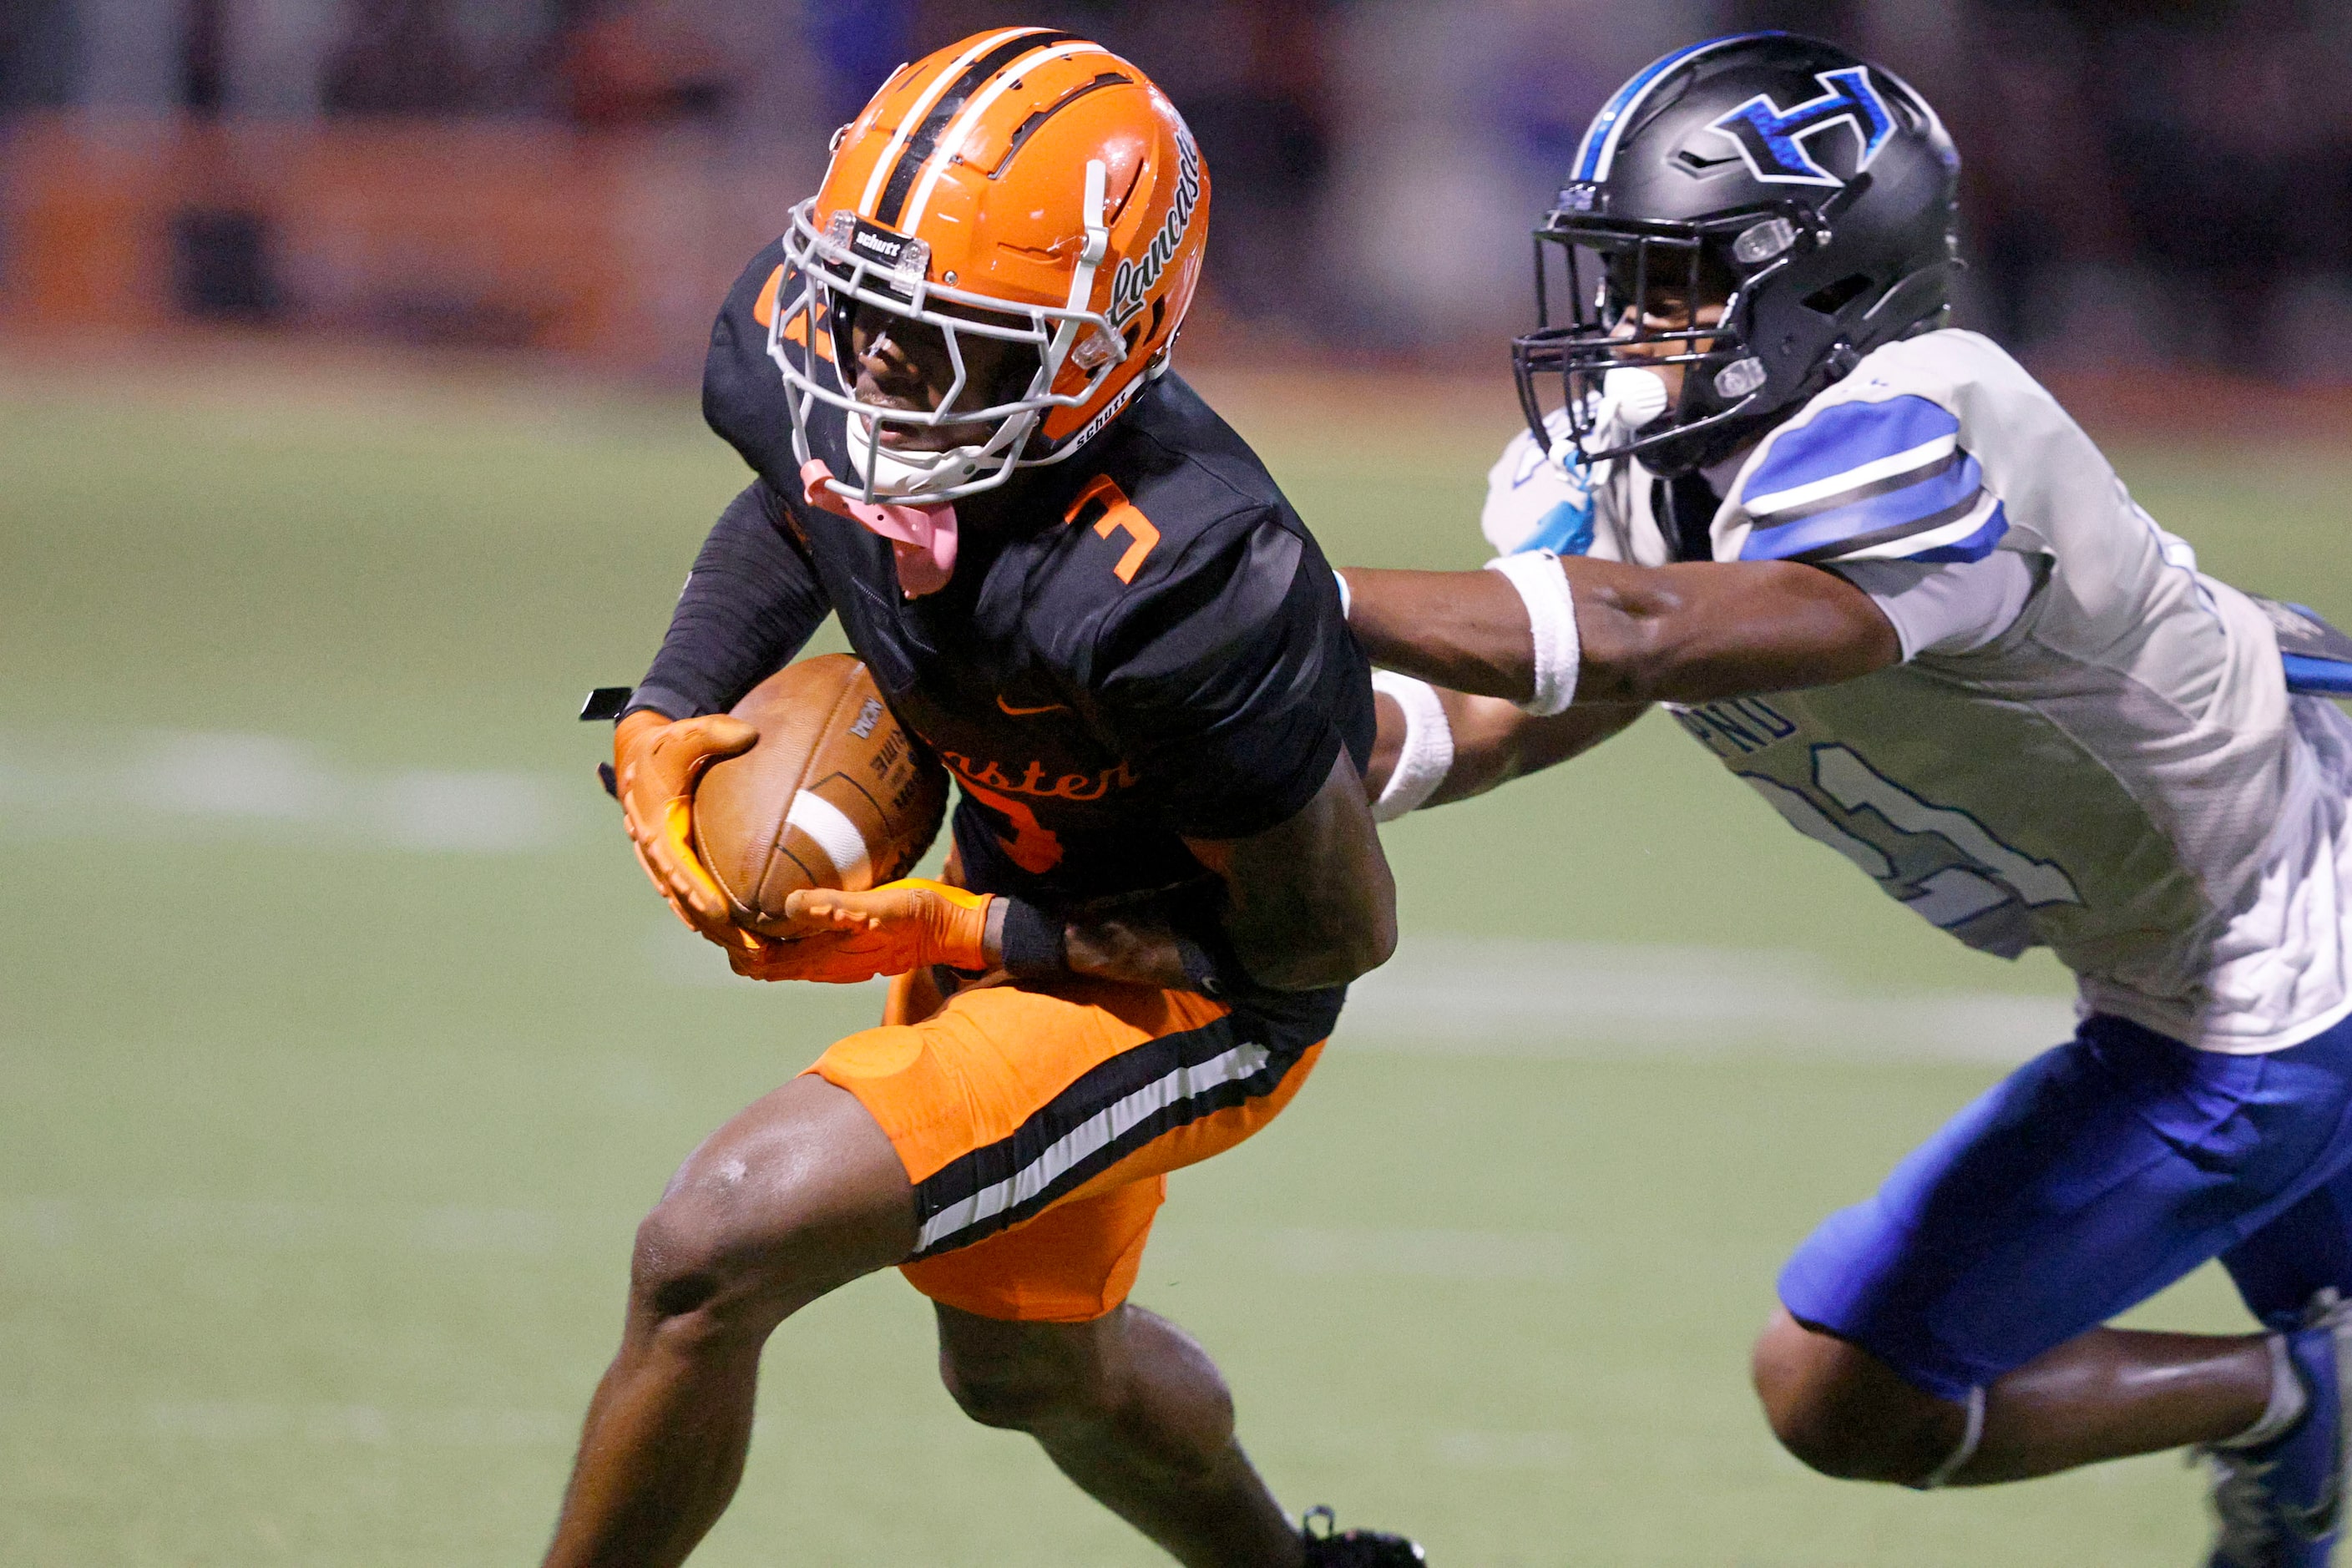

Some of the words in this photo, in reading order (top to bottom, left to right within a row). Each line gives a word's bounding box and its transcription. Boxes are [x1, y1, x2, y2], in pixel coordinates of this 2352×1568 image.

[856, 230, 901, 257] schutt
[1076, 392, 1125, 449] schutt
[1063, 473, 1161, 585] 3
